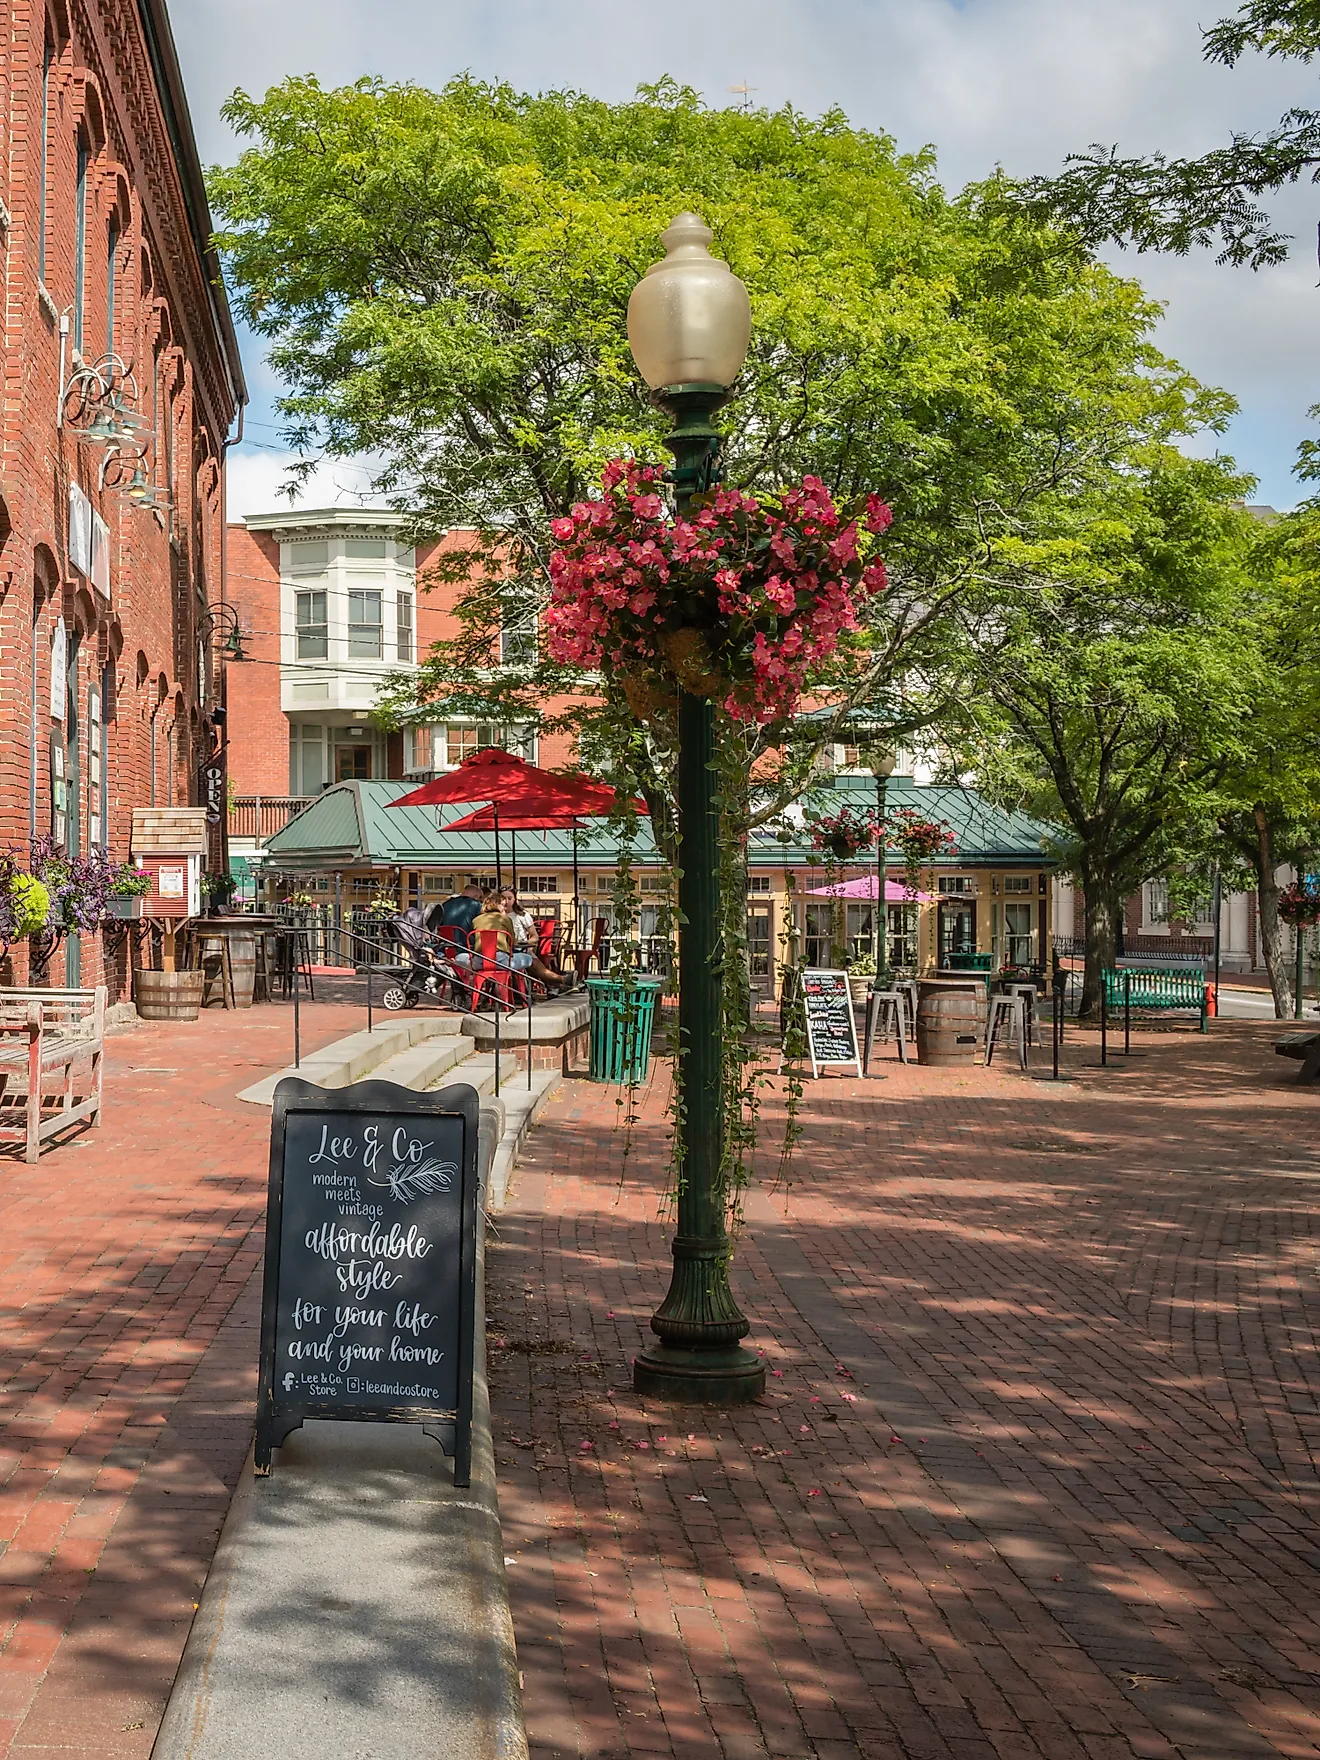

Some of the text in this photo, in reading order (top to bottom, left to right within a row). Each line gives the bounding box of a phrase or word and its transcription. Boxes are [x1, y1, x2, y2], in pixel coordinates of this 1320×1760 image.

[206, 768, 222, 813] OPEN
[308, 1124, 434, 1173] Lee & Co
[312, 1170, 357, 1187] modern
[325, 1188, 361, 1202] meets
[338, 1202, 384, 1222] vintage
[305, 1220, 433, 1260] affordable
[336, 1258, 402, 1300] style
[291, 1297, 439, 1338] for your life
[288, 1333, 444, 1373] and your home
[300, 1372, 319, 1384] Lee
[320, 1372, 328, 1384] &
[329, 1372, 343, 1385] Co.
[309, 1384, 338, 1396] Store
